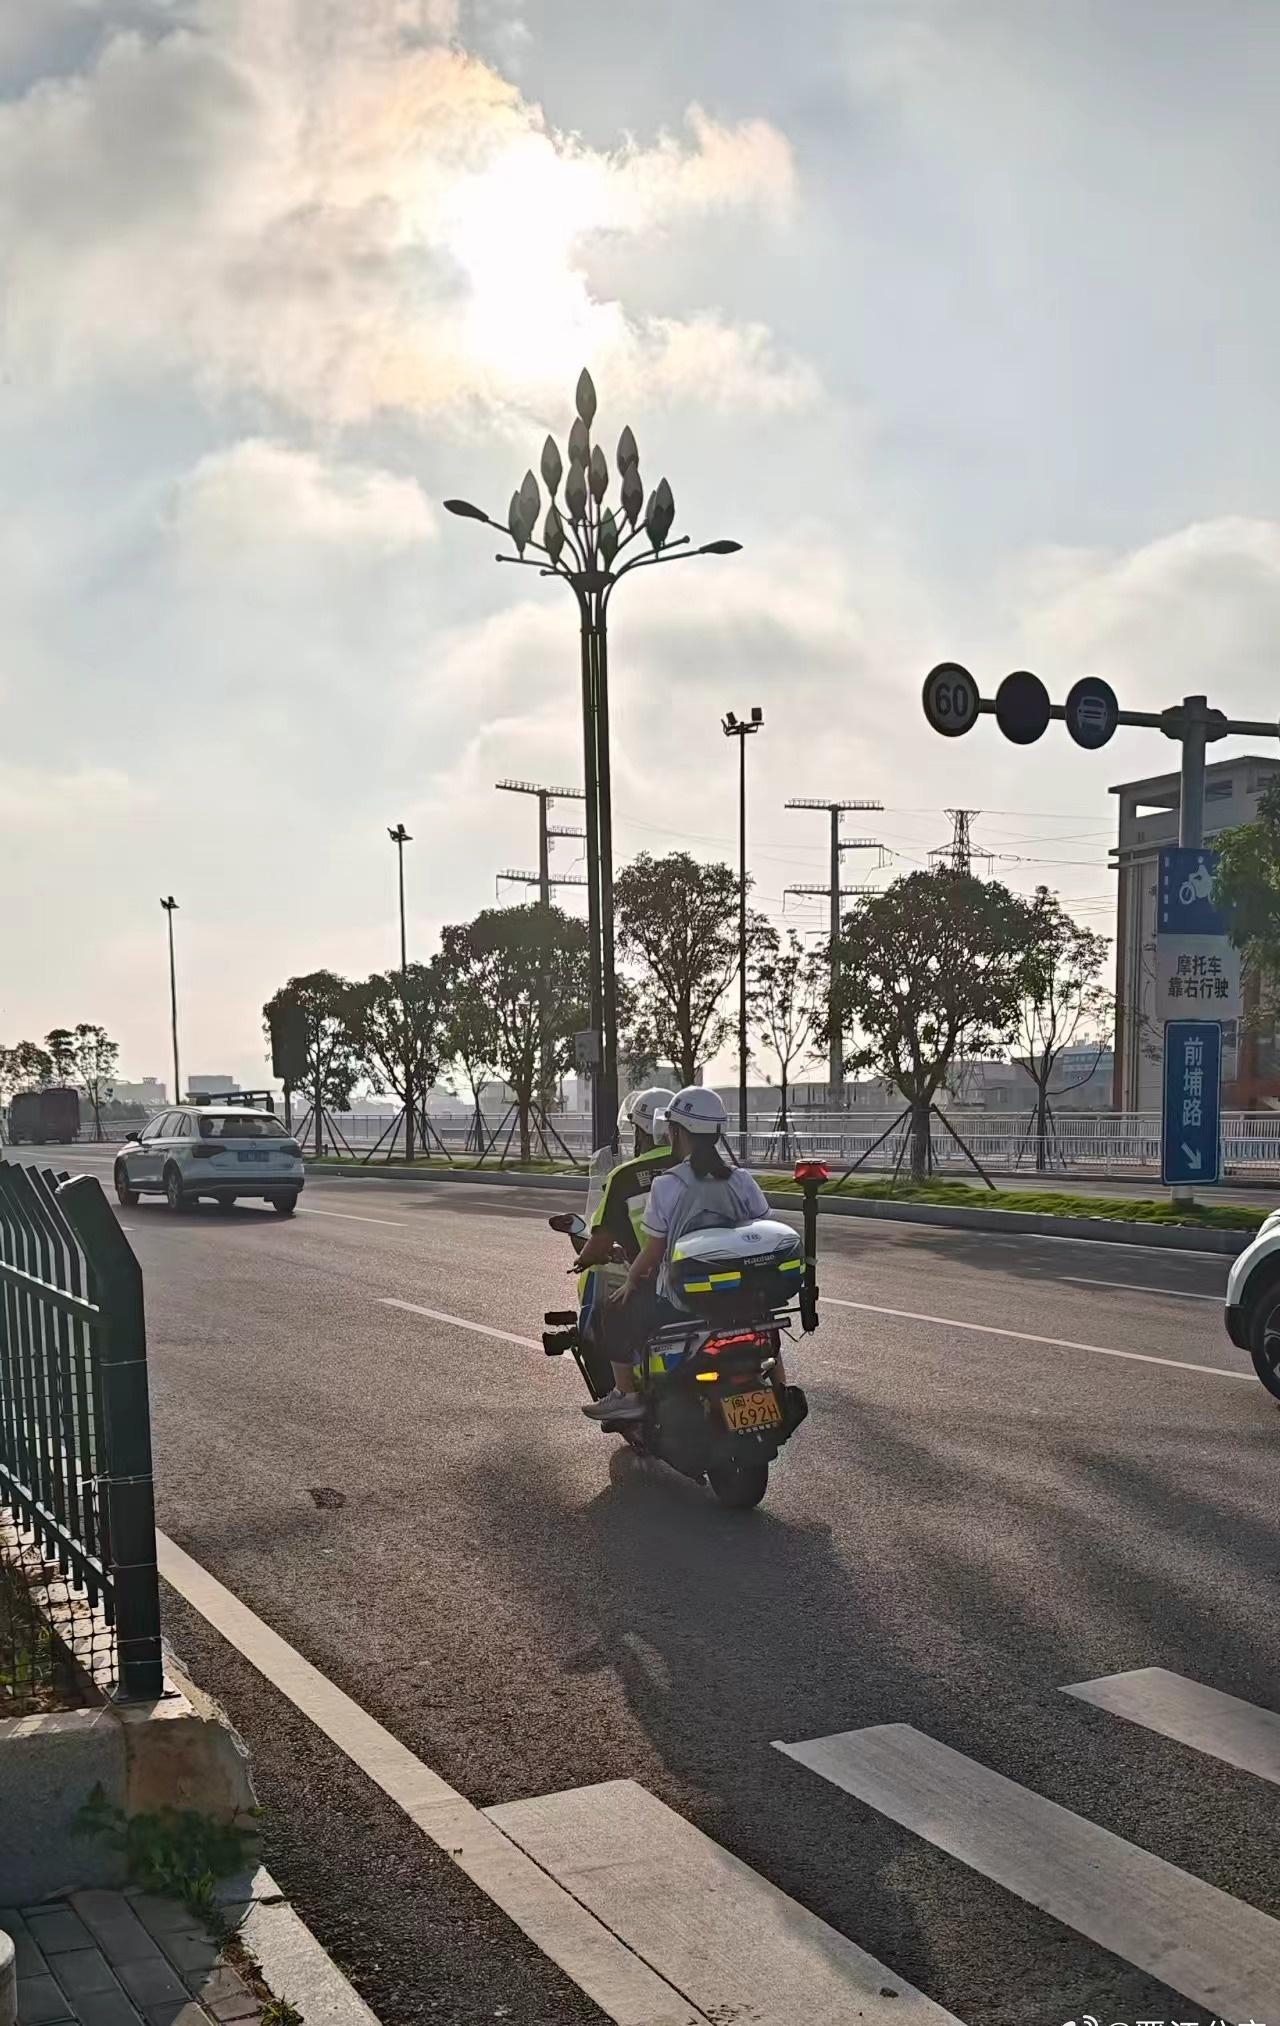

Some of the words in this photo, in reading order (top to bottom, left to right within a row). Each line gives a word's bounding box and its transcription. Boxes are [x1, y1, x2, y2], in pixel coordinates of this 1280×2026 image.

[935, 682, 969, 717] 60
[1176, 954, 1222, 976] 摩托车
[1168, 976, 1229, 999] 靠右行驶
[1182, 1036, 1204, 1127] 前埔路
[728, 1404, 779, 1428] V692H
